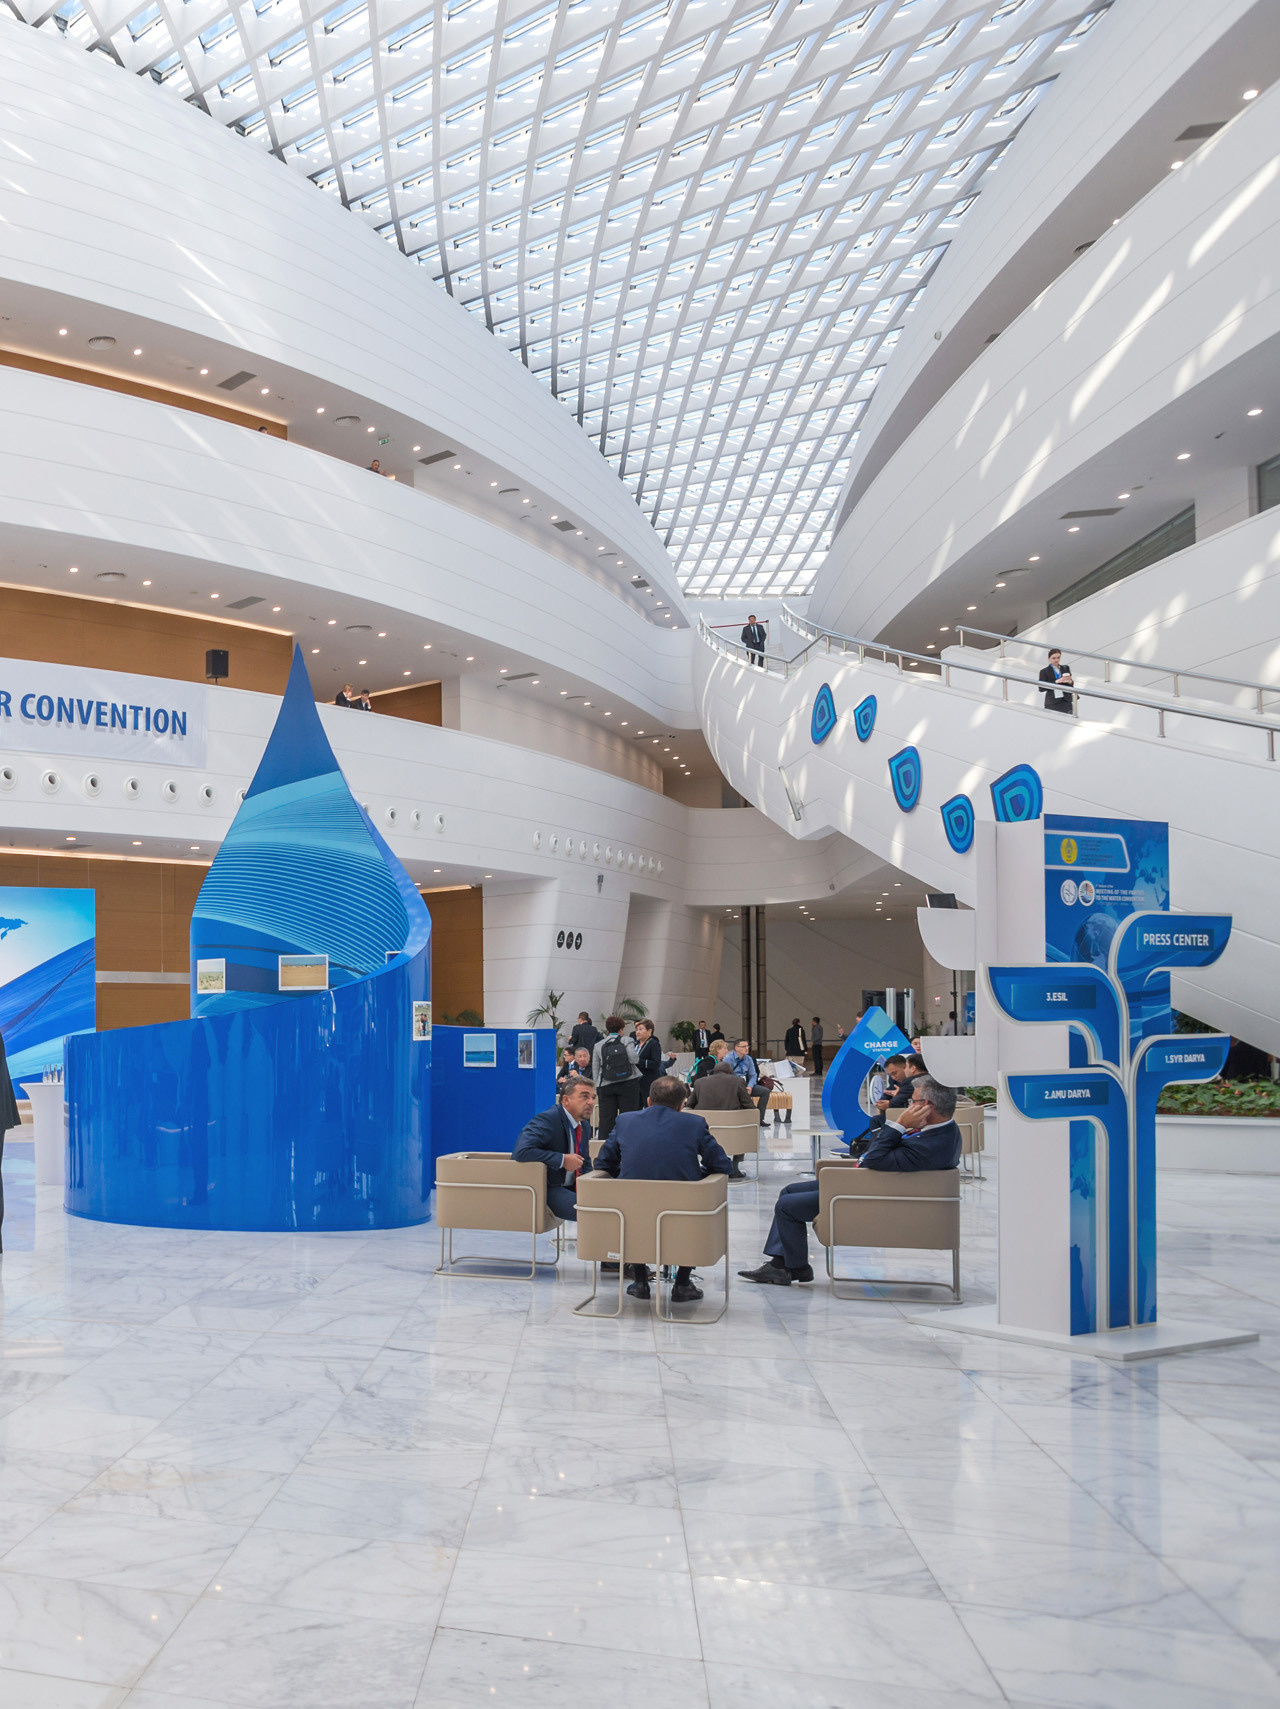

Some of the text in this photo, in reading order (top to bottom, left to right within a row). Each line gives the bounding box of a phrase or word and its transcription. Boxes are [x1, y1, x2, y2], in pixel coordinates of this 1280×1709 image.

[20, 693, 187, 736] CONVENTION
[1143, 933, 1209, 946] PRESS CENTER
[1165, 1054, 1205, 1063] 1.SYR DARYA
[1045, 1089, 1090, 1099] 2.AMU DARYA
